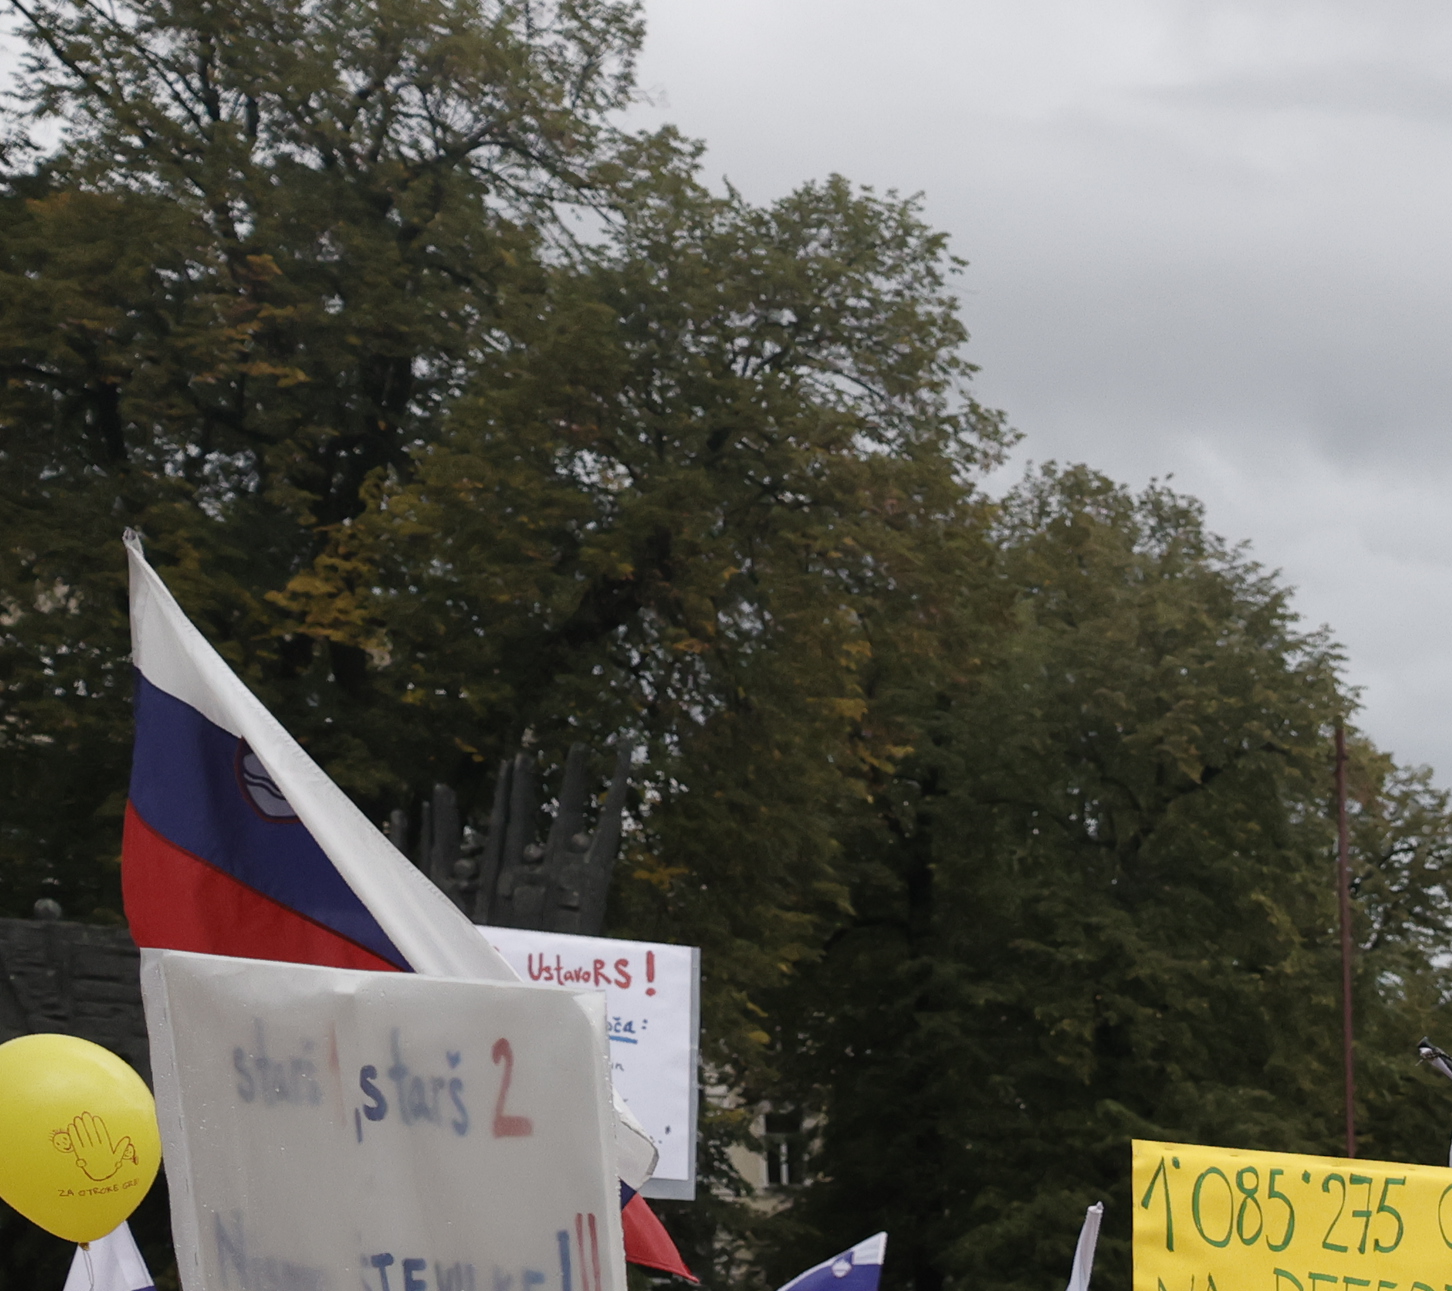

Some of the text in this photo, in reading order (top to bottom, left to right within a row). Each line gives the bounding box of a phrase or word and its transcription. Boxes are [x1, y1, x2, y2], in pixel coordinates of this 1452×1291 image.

[491, 1037, 534, 1138] 2
[58, 1188, 75, 1198] ZA
[78, 1183, 120, 1197] OTROKE
